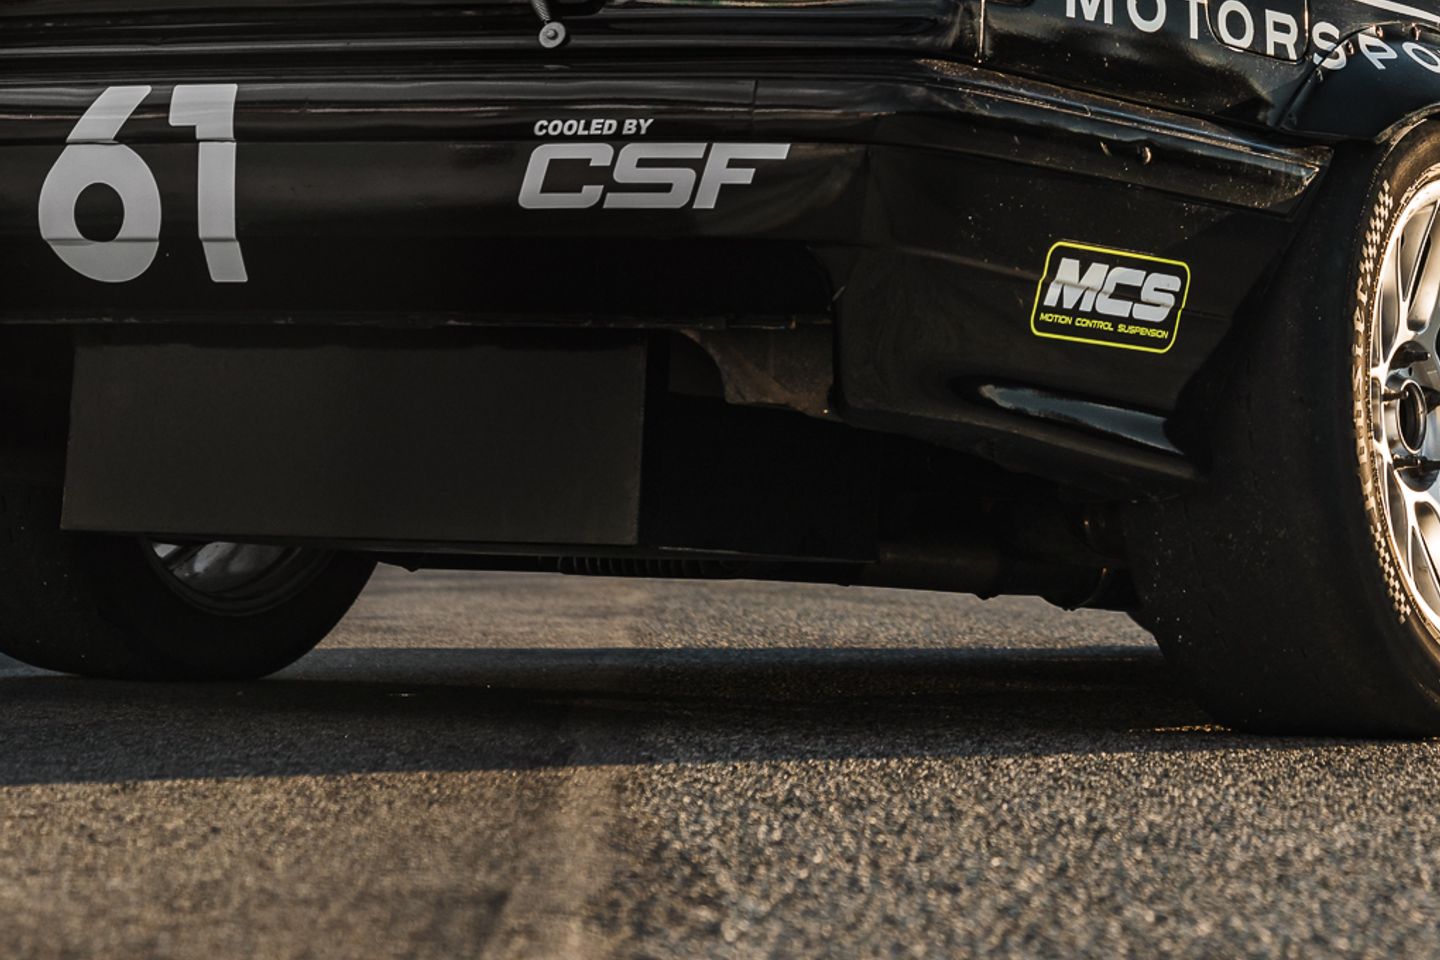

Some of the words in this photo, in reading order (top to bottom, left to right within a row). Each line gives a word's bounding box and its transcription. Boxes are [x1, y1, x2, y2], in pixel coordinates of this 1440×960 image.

[533, 119, 617, 136] COOLED
[622, 118, 654, 135] BY
[38, 84, 248, 283] 61
[518, 142, 791, 209] CSF
[1039, 312, 1073, 326] MOTION
[1075, 317, 1114, 332] CONTROL
[1043, 257, 1182, 322] MCS
